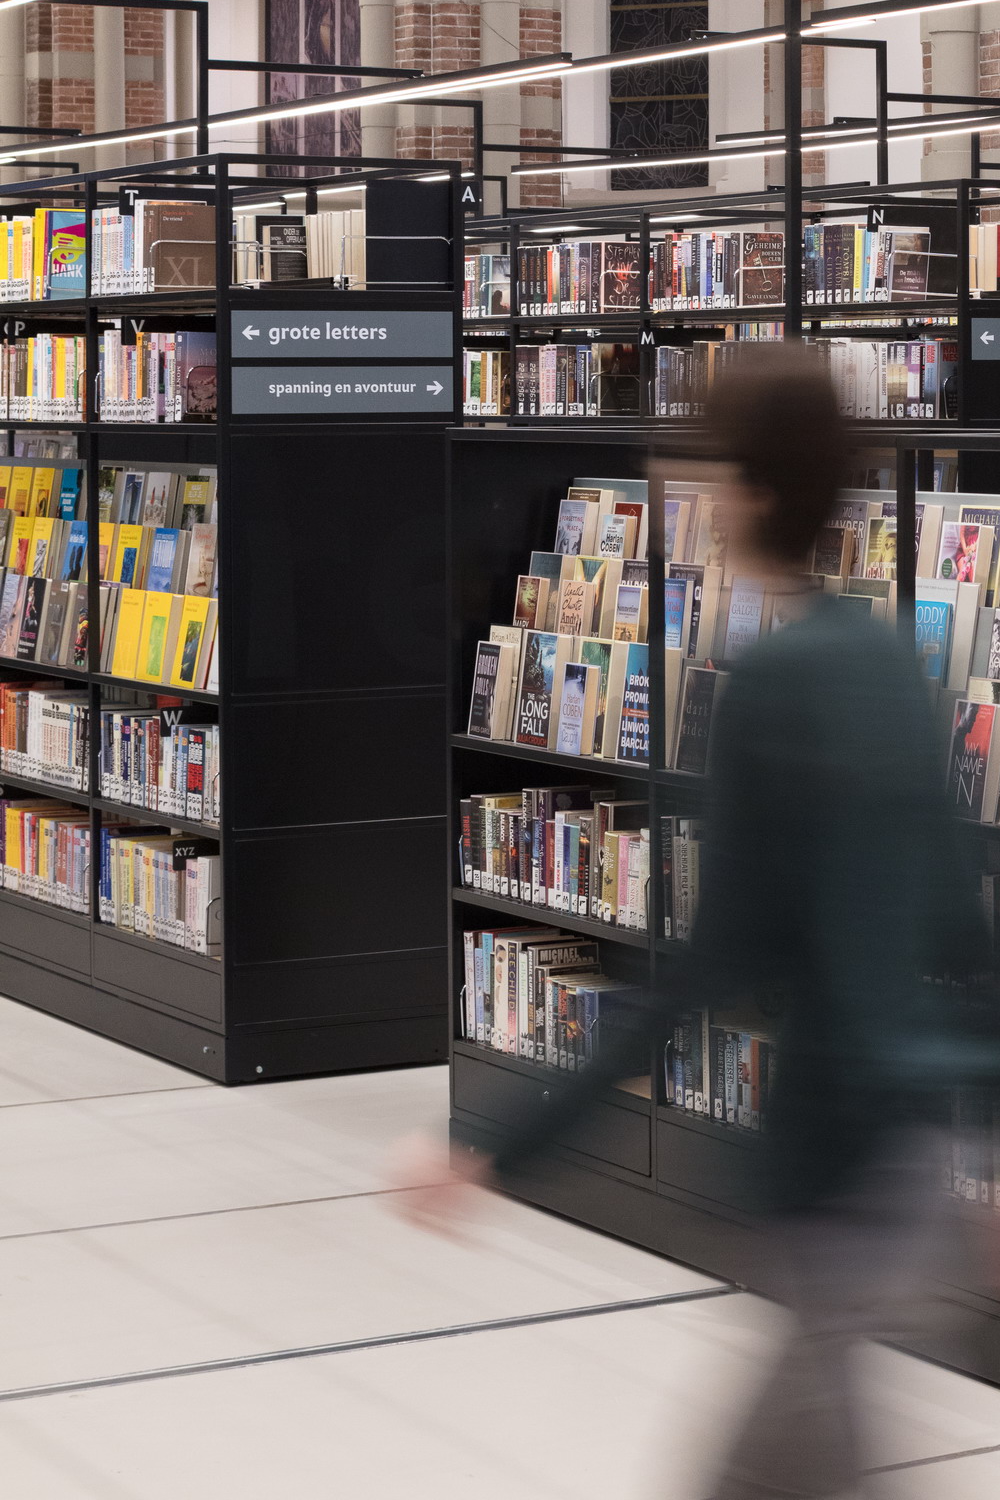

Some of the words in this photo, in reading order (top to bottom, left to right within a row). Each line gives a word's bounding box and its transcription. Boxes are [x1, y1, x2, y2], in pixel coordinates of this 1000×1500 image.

[125, 189, 139, 206] T
[462, 186, 475, 202] A
[873, 209, 884, 224] N
[745, 237, 782, 254] GEHEIME
[52, 263, 83, 278] HANK
[164, 255, 213, 287] XL
[130, 319, 145, 334] V
[268, 325, 321, 345] grote
[325, 322, 387, 340] letters
[641, 331, 656, 345] M
[268, 381, 332, 397] spanning
[334, 384, 351, 393] en
[354, 381, 416, 393] avontuur
[964, 513, 1000, 526] MICHAEL
[606, 533, 623, 543] Harlan
[600, 540, 620, 553] COBEN
[566, 693, 581, 704] Harlan
[520, 698, 548, 718] LONG
[563, 703, 582, 719] COBEN
[163, 710, 183, 726] W
[521, 715, 545, 738] FALL
[964, 741, 979, 757] MY
[954, 755, 984, 776] NAME
[464, 838, 471, 847] ME
[175, 846, 195, 857] XYZ
[508, 943, 516, 968] LEE
[726, 1043, 734, 1085] GERRITSEN
